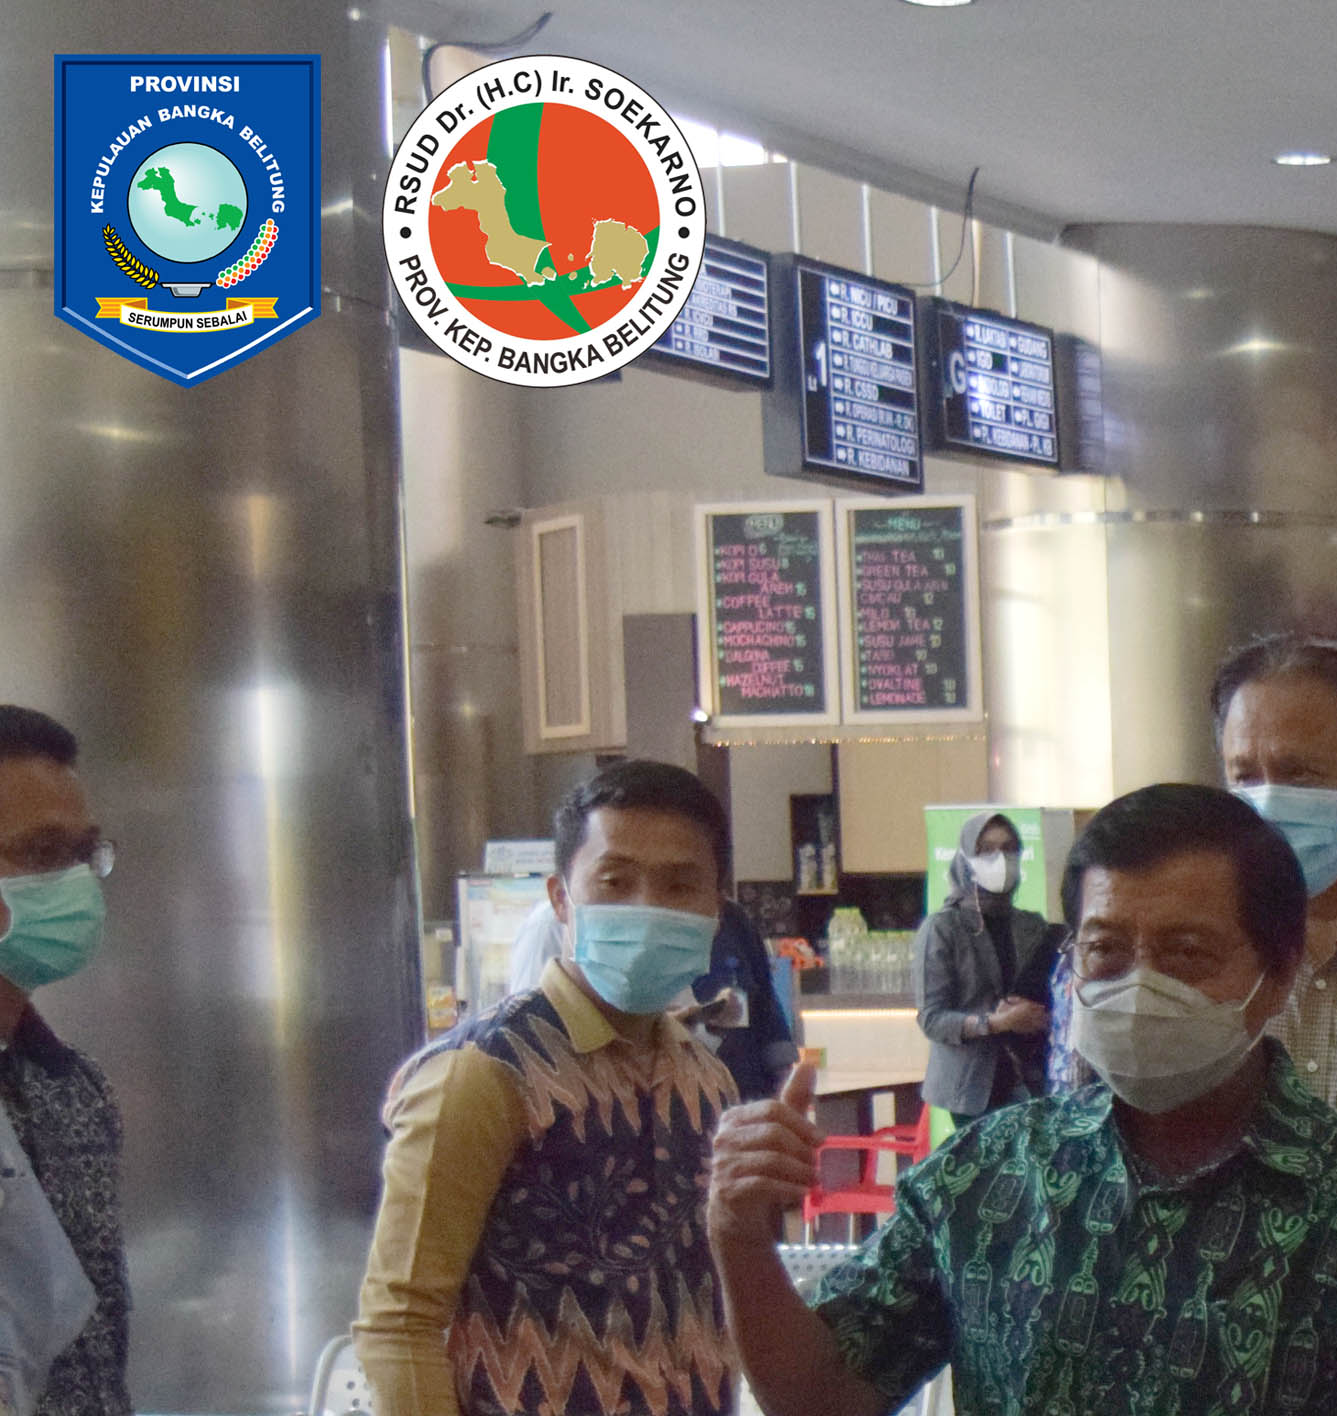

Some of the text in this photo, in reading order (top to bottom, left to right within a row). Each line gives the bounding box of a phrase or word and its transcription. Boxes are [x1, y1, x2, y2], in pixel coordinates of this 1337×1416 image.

[841, 306, 873, 331] R. ICCU
[842, 330, 893, 359] R. CATHLAB
[815, 342, 827, 387] 1
[950, 352, 967, 395] G
[844, 378, 879, 401] R. CSSD
[847, 424, 856, 441] R.
[848, 446, 910, 477] R. KEBIDANAN
[888, 517, 921, 530] MENU
[892, 549, 917, 562] TEA
[905, 564, 929, 577] TEA
[723, 595, 770, 609] COFFEE
[759, 605, 802, 618] LATTE
